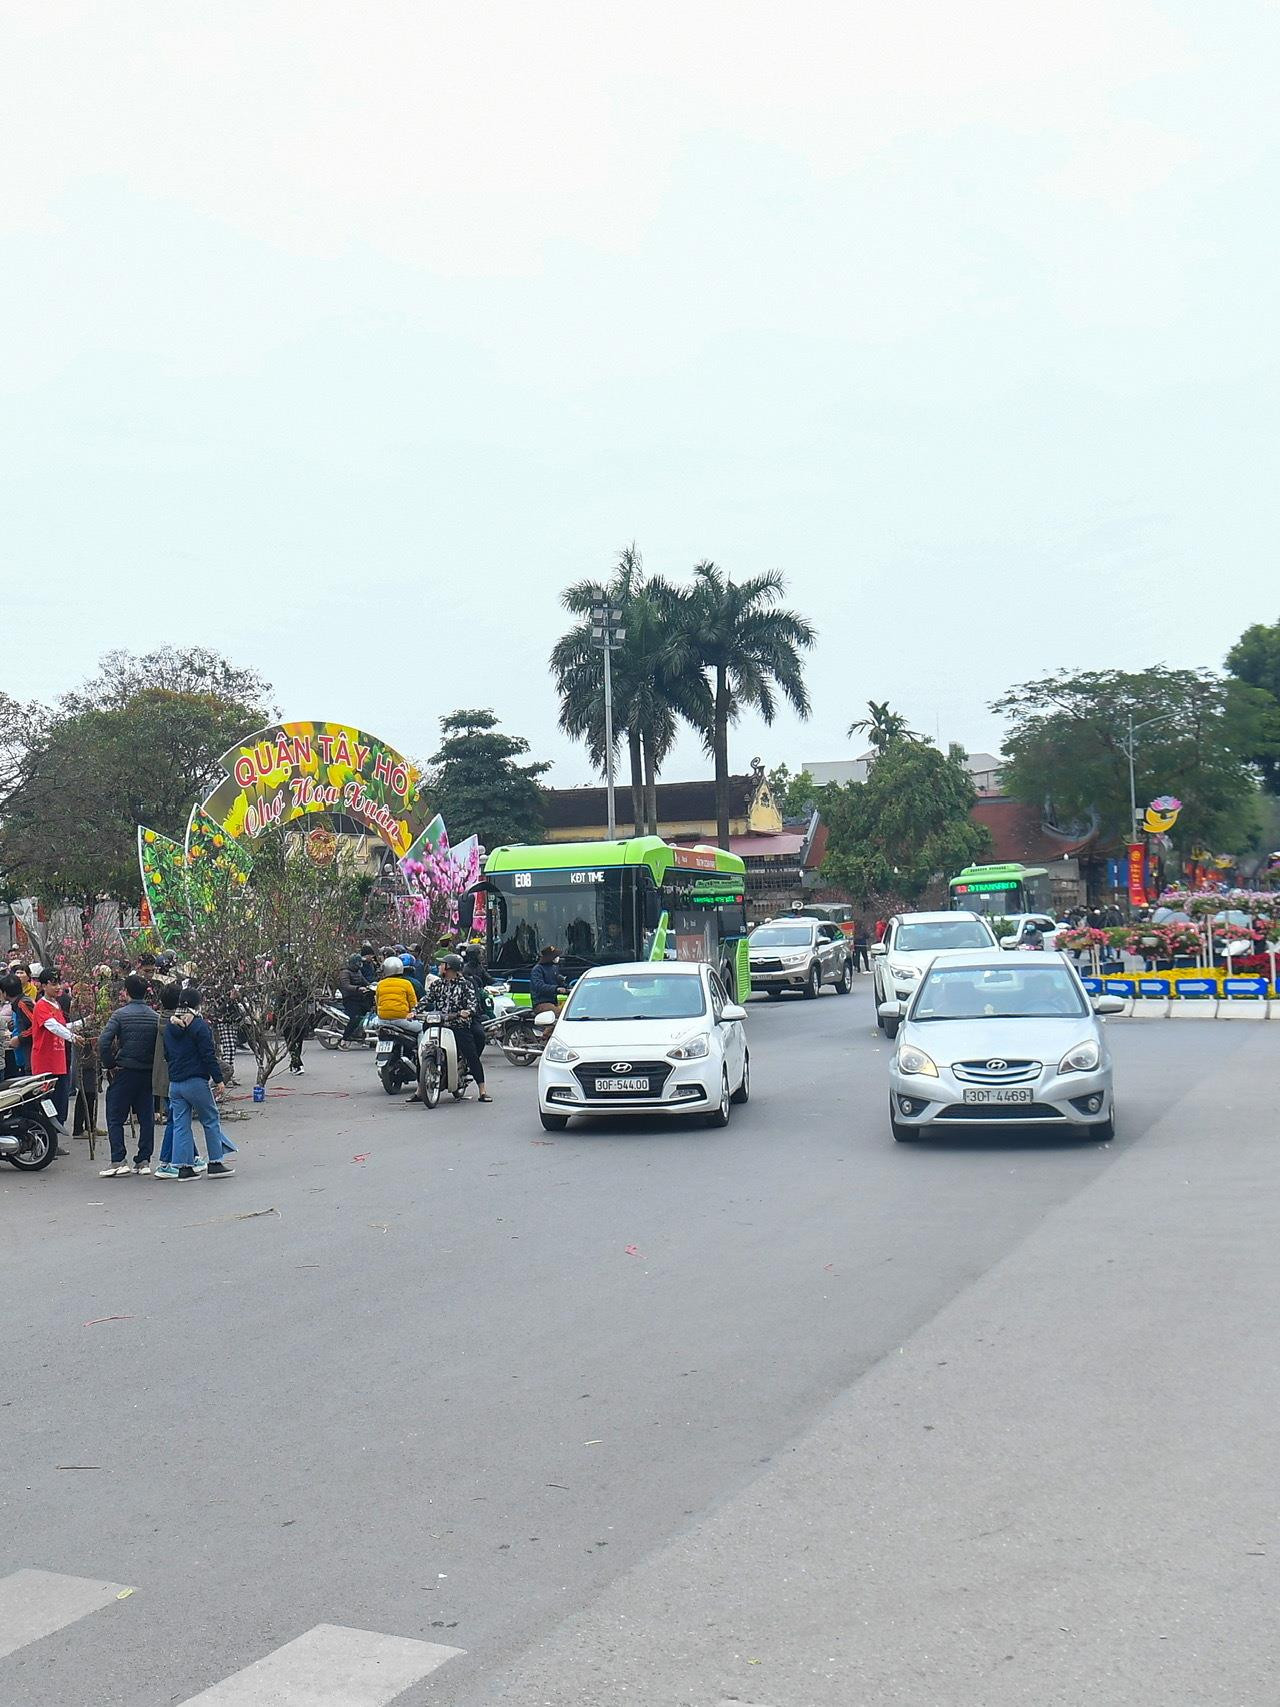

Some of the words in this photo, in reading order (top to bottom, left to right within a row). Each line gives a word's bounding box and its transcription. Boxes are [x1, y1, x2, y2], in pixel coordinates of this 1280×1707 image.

[234, 732, 311, 788] QUẬN
[318, 731, 370, 772] TÂY
[244, 789, 285, 838] Chợ
[289, 776, 339, 806] Hoa
[344, 782, 400, 839] Xuân
